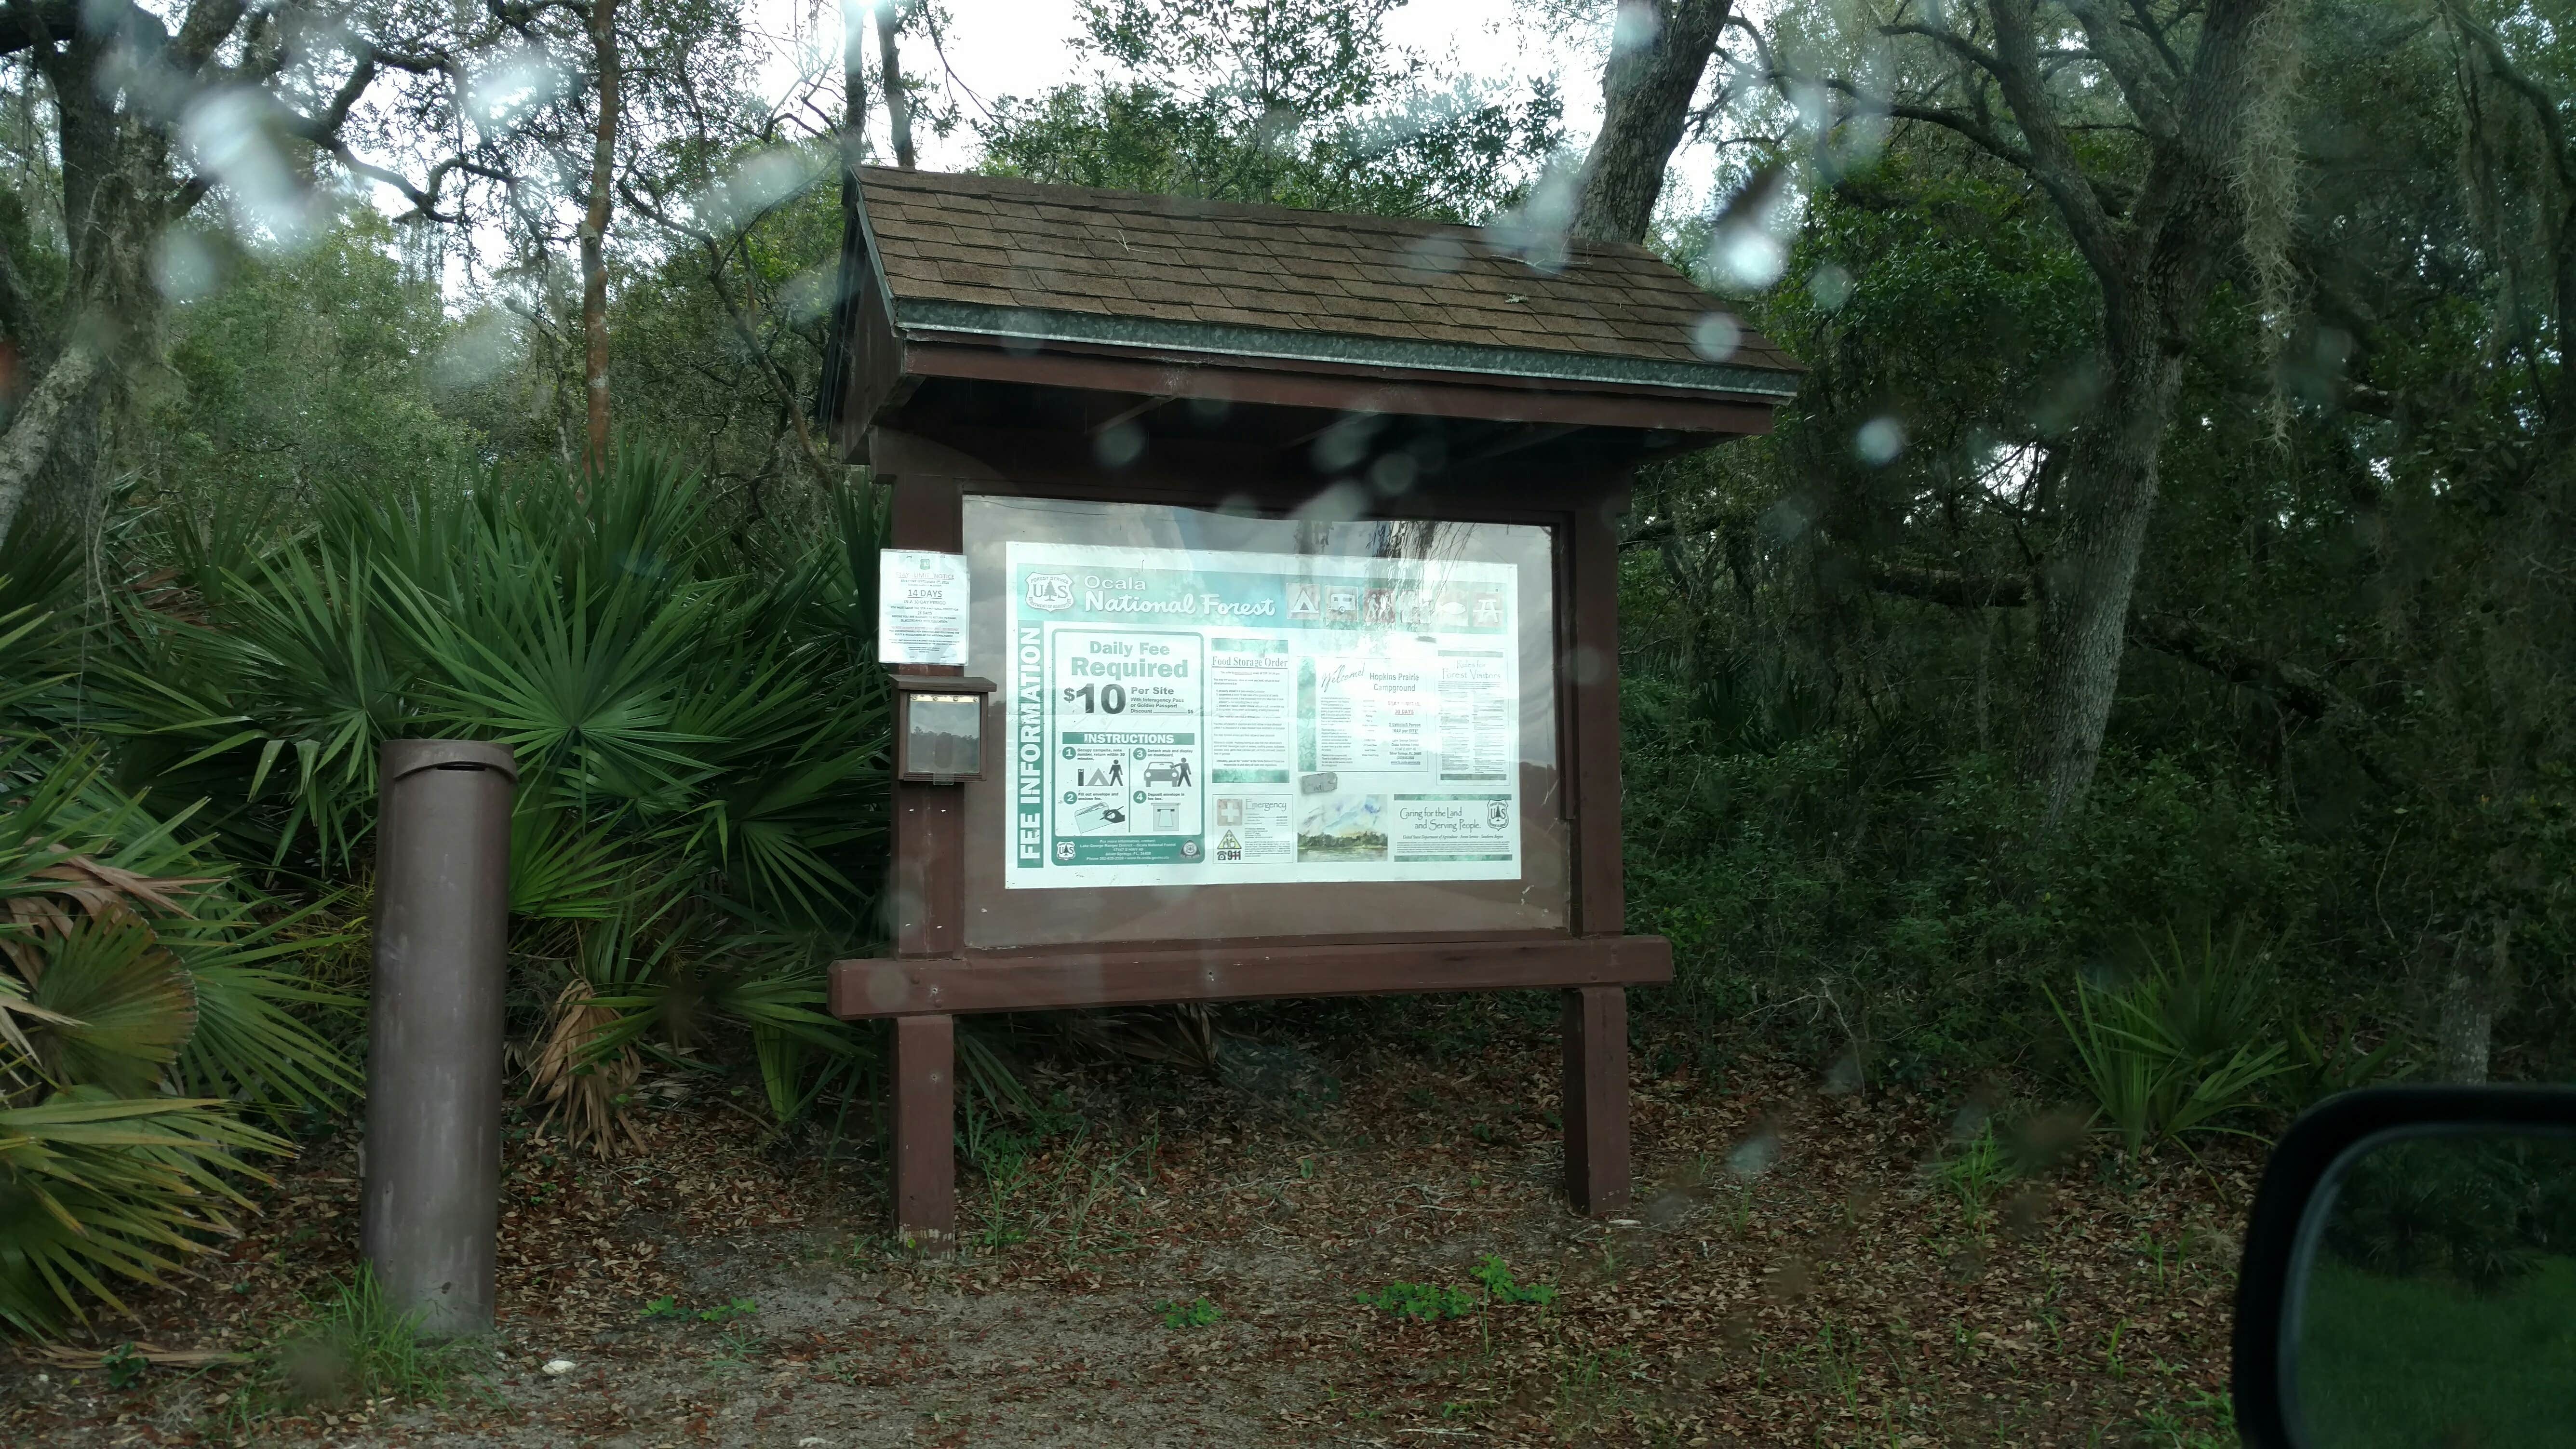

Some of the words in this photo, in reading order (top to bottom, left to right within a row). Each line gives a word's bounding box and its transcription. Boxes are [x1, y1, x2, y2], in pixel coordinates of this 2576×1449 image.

[1084, 576, 1146, 590] Ocala
[1085, 590, 1196, 615] National
[1199, 593, 1276, 617] Forest
[1090, 641, 1133, 657] Daily
[1140, 642, 1170, 655] Fee
[1212, 656, 1231, 666] Food
[1234, 657, 1263, 667] Storage
[1264, 657, 1288, 667] Order
[1457, 659, 1475, 669] Rules
[1071, 657, 1188, 681] Required
[1442, 668, 1467, 679] Forest
[1469, 669, 1501, 680] Visitors
[1369, 672, 1396, 682] Hopkins
[1131, 686, 1149, 695] Per
[1374, 684, 1416, 693] Campground
[1063, 683, 1127, 714] $10
[1020, 627, 1041, 804] INFORMATION
[1084, 734, 1174, 744] INSTRUCTIONS
[1246, 798, 1287, 811] Emergency
[1400, 807, 1423, 820] Caring
[1424, 807, 1434, 817] for
[1435, 807, 1446, 817] the
[1447, 806, 1462, 818] Land
[1414, 819, 1427, 829] and
[1428, 819, 1457, 832] Serving
[1459, 818, 1481, 832] People.
[1020, 813, 1041, 859] FEE
